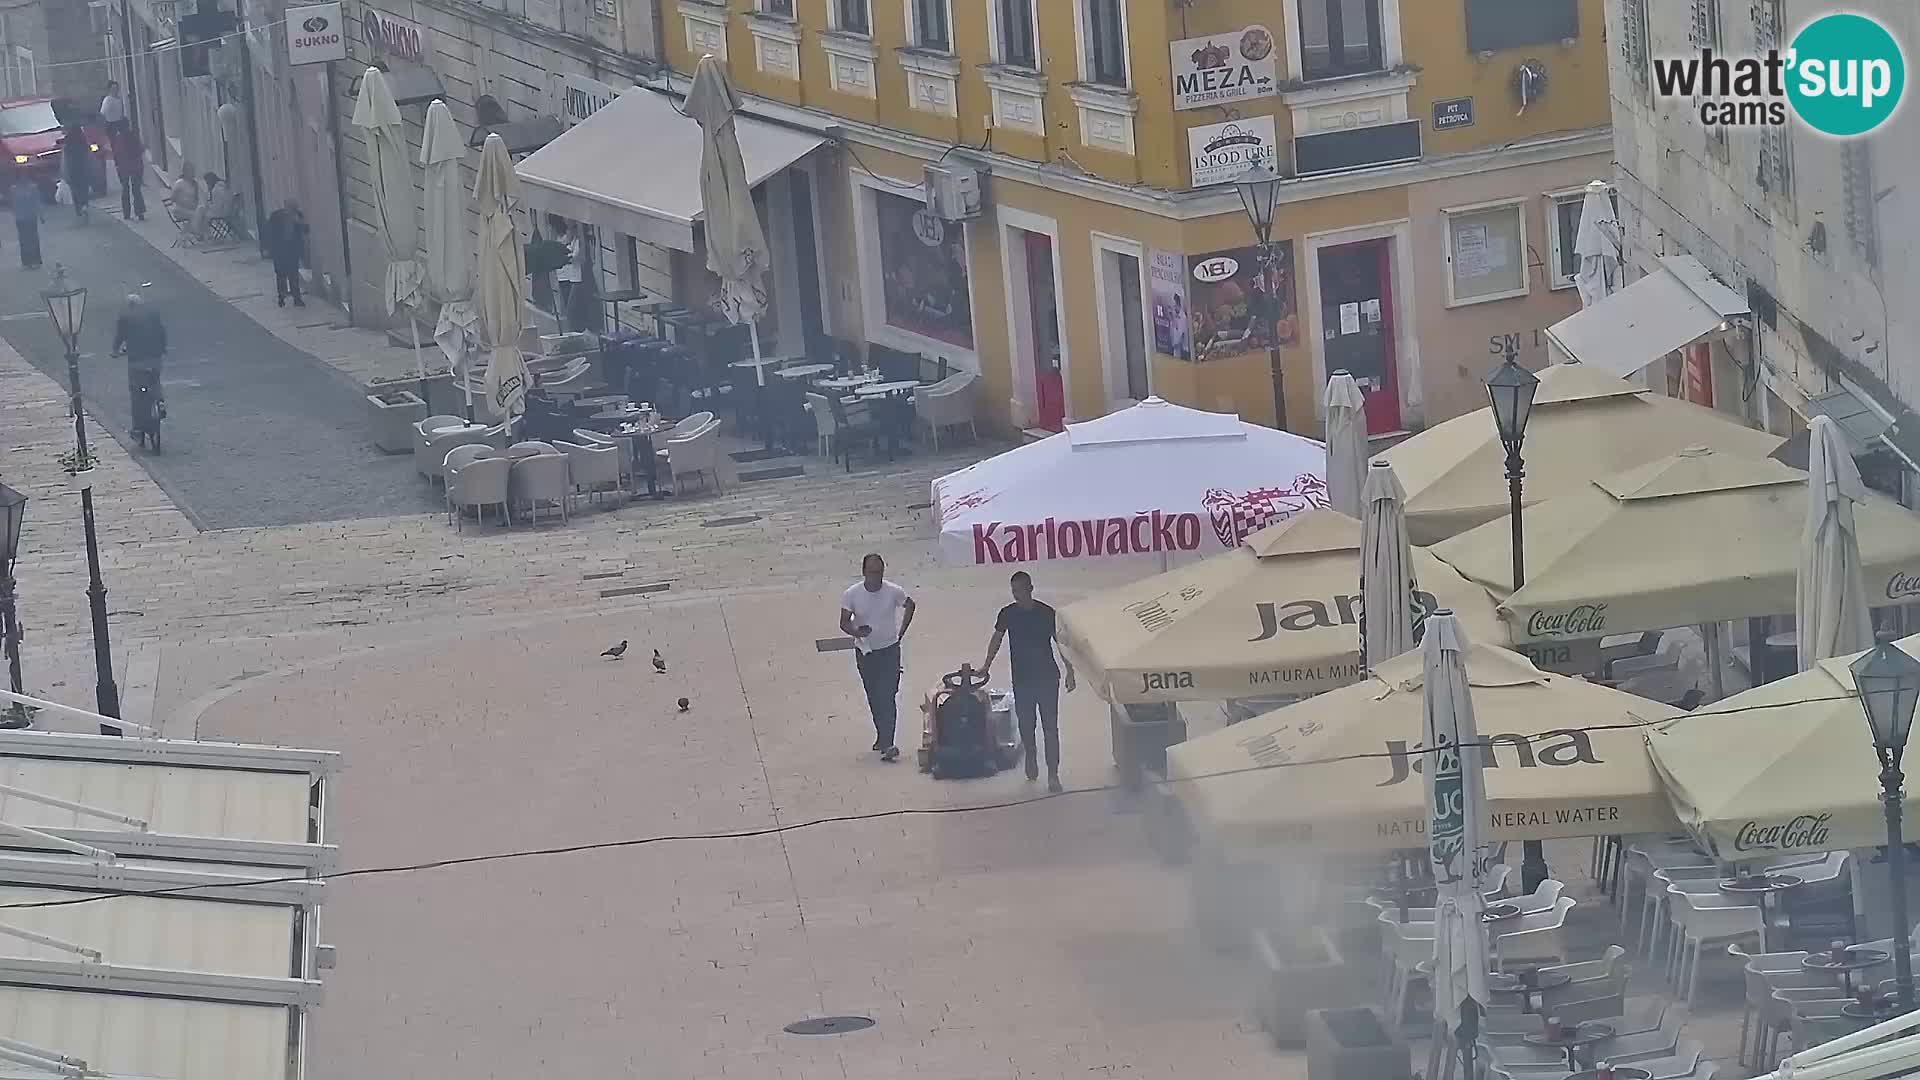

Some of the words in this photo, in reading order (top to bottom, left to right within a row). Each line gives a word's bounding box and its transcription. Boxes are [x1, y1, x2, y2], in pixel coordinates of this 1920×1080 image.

[295, 34, 339, 48] SUKNO
[381, 18, 421, 58] SUKNO
[1176, 65, 1255, 96] MEZA
[1186, 91, 1219, 104] PIZZERIA
[1226, 87, 1247, 98] GRILL
[1447, 104, 1458, 113] PUT
[1195, 150, 1241, 169] ISPOD
[973, 510, 1201, 565] Karlovačko
[1249, 668, 1326, 685] NATURAL
[1329, 663, 1360, 680] MIN
[1377, 819, 1426, 838] NATU
[1555, 806, 1619, 824] WATER
